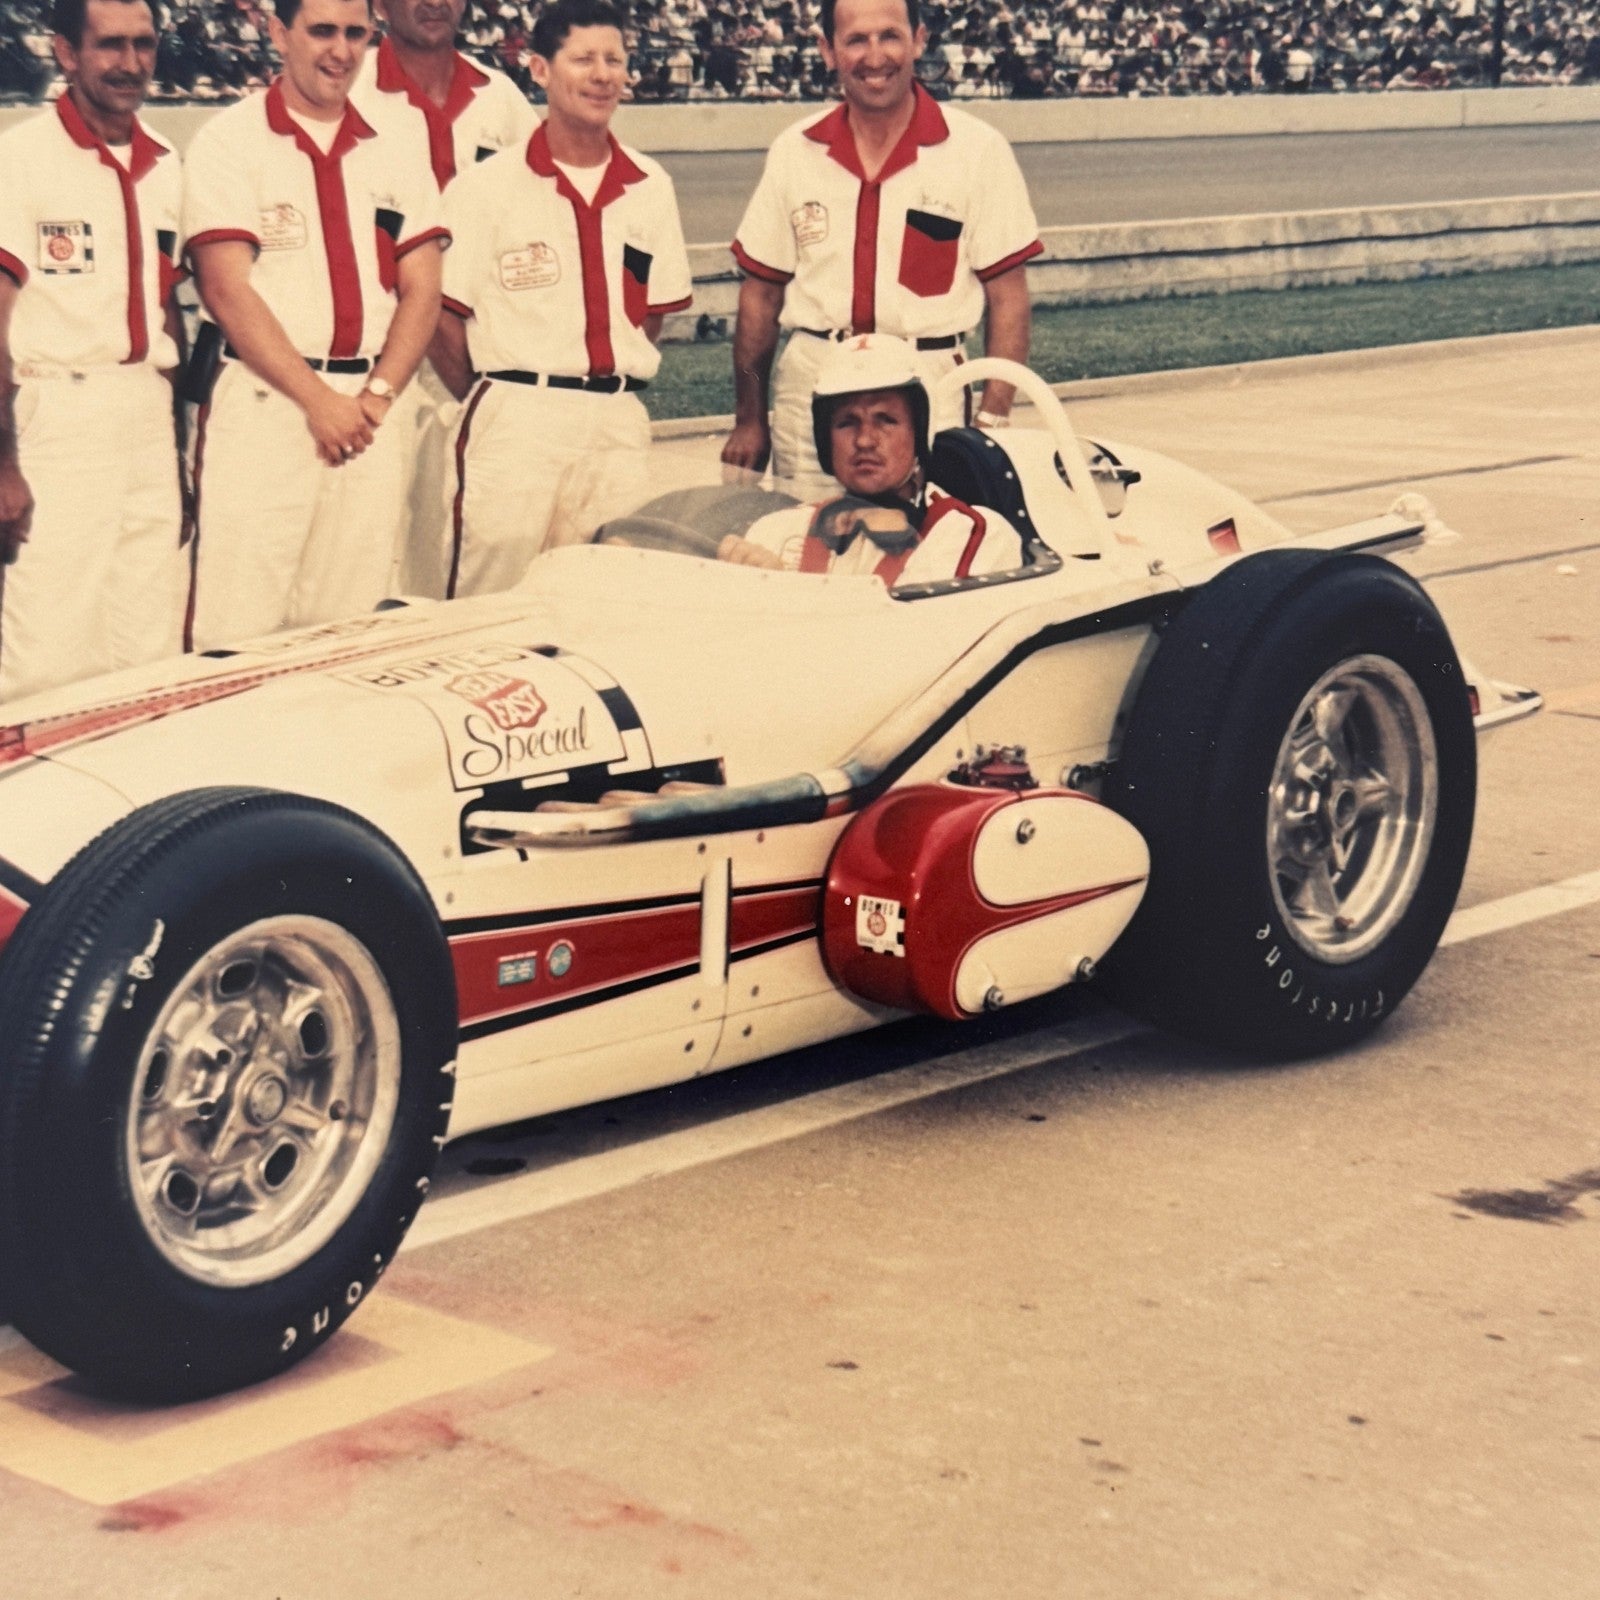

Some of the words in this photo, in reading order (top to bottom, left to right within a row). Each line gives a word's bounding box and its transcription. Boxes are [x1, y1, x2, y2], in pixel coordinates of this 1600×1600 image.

[42, 225, 80, 237] BOWES
[357, 649, 527, 687] BOWES
[462, 705, 592, 778] Special
